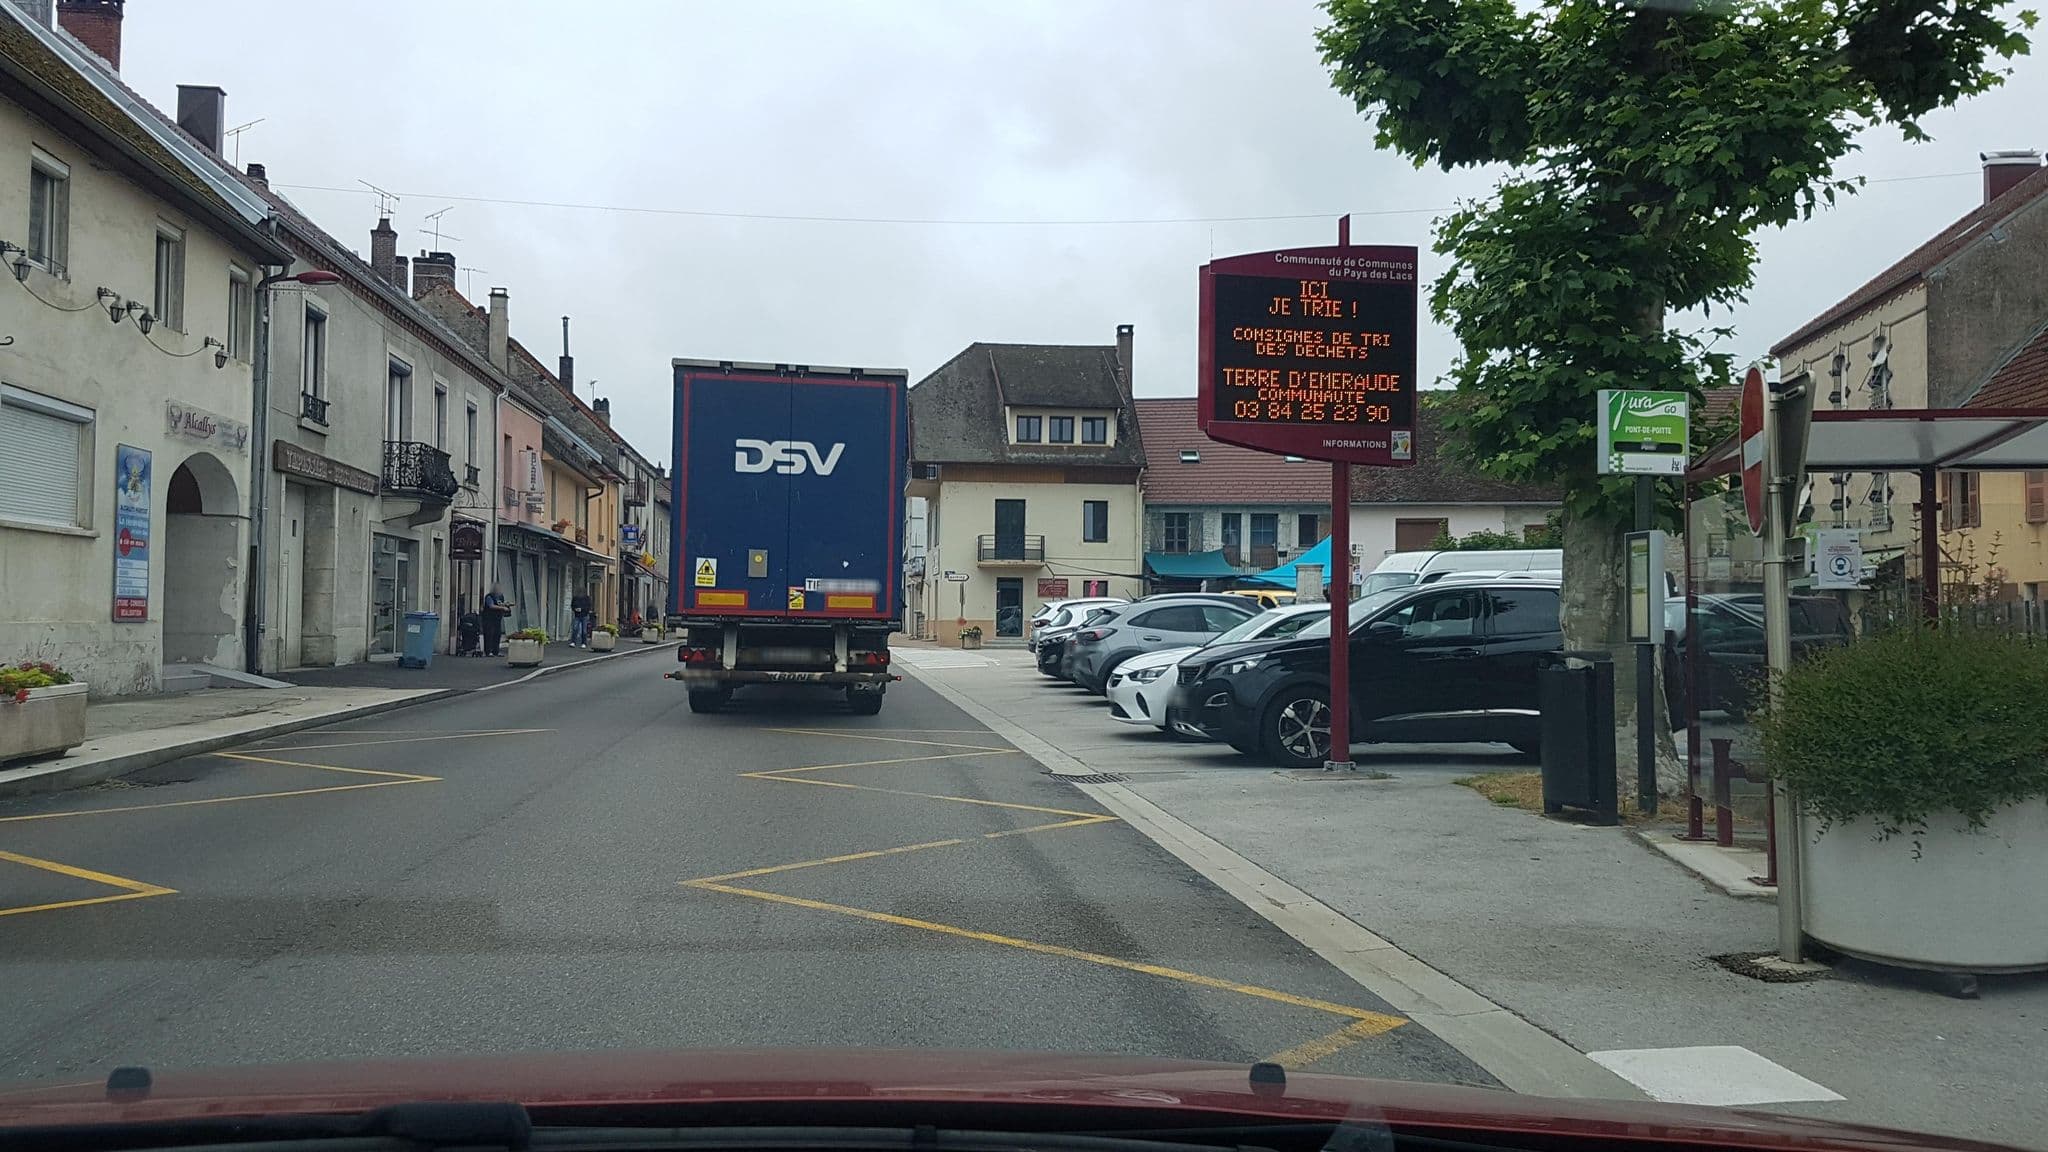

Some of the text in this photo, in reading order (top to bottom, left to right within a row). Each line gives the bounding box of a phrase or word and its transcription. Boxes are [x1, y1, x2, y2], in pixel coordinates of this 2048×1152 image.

[1275, 253, 1413, 270] Communauté de Communes
[1329, 268, 1413, 280] du Pays des Lacs
[1300, 280, 1329, 298] ICI
[1269, 298, 1357, 318] JE TRIE !
[1233, 328, 1391, 346] CONSIGNES DE TRI
[1256, 343, 1369, 359] DES DECHETS
[1223, 368, 1400, 392] TERRE D'EMERAUDE
[1258, 388, 1366, 404] COMMUNAUTE
[1235, 401, 1390, 422] 03 84 25 23 90
[1609, 391, 1676, 431] Jura GO
[1625, 426, 1672, 434] PONT-DE-POITTE
[1323, 439, 1387, 449] INFORMATIONS
[735, 438, 846, 476] DSV
